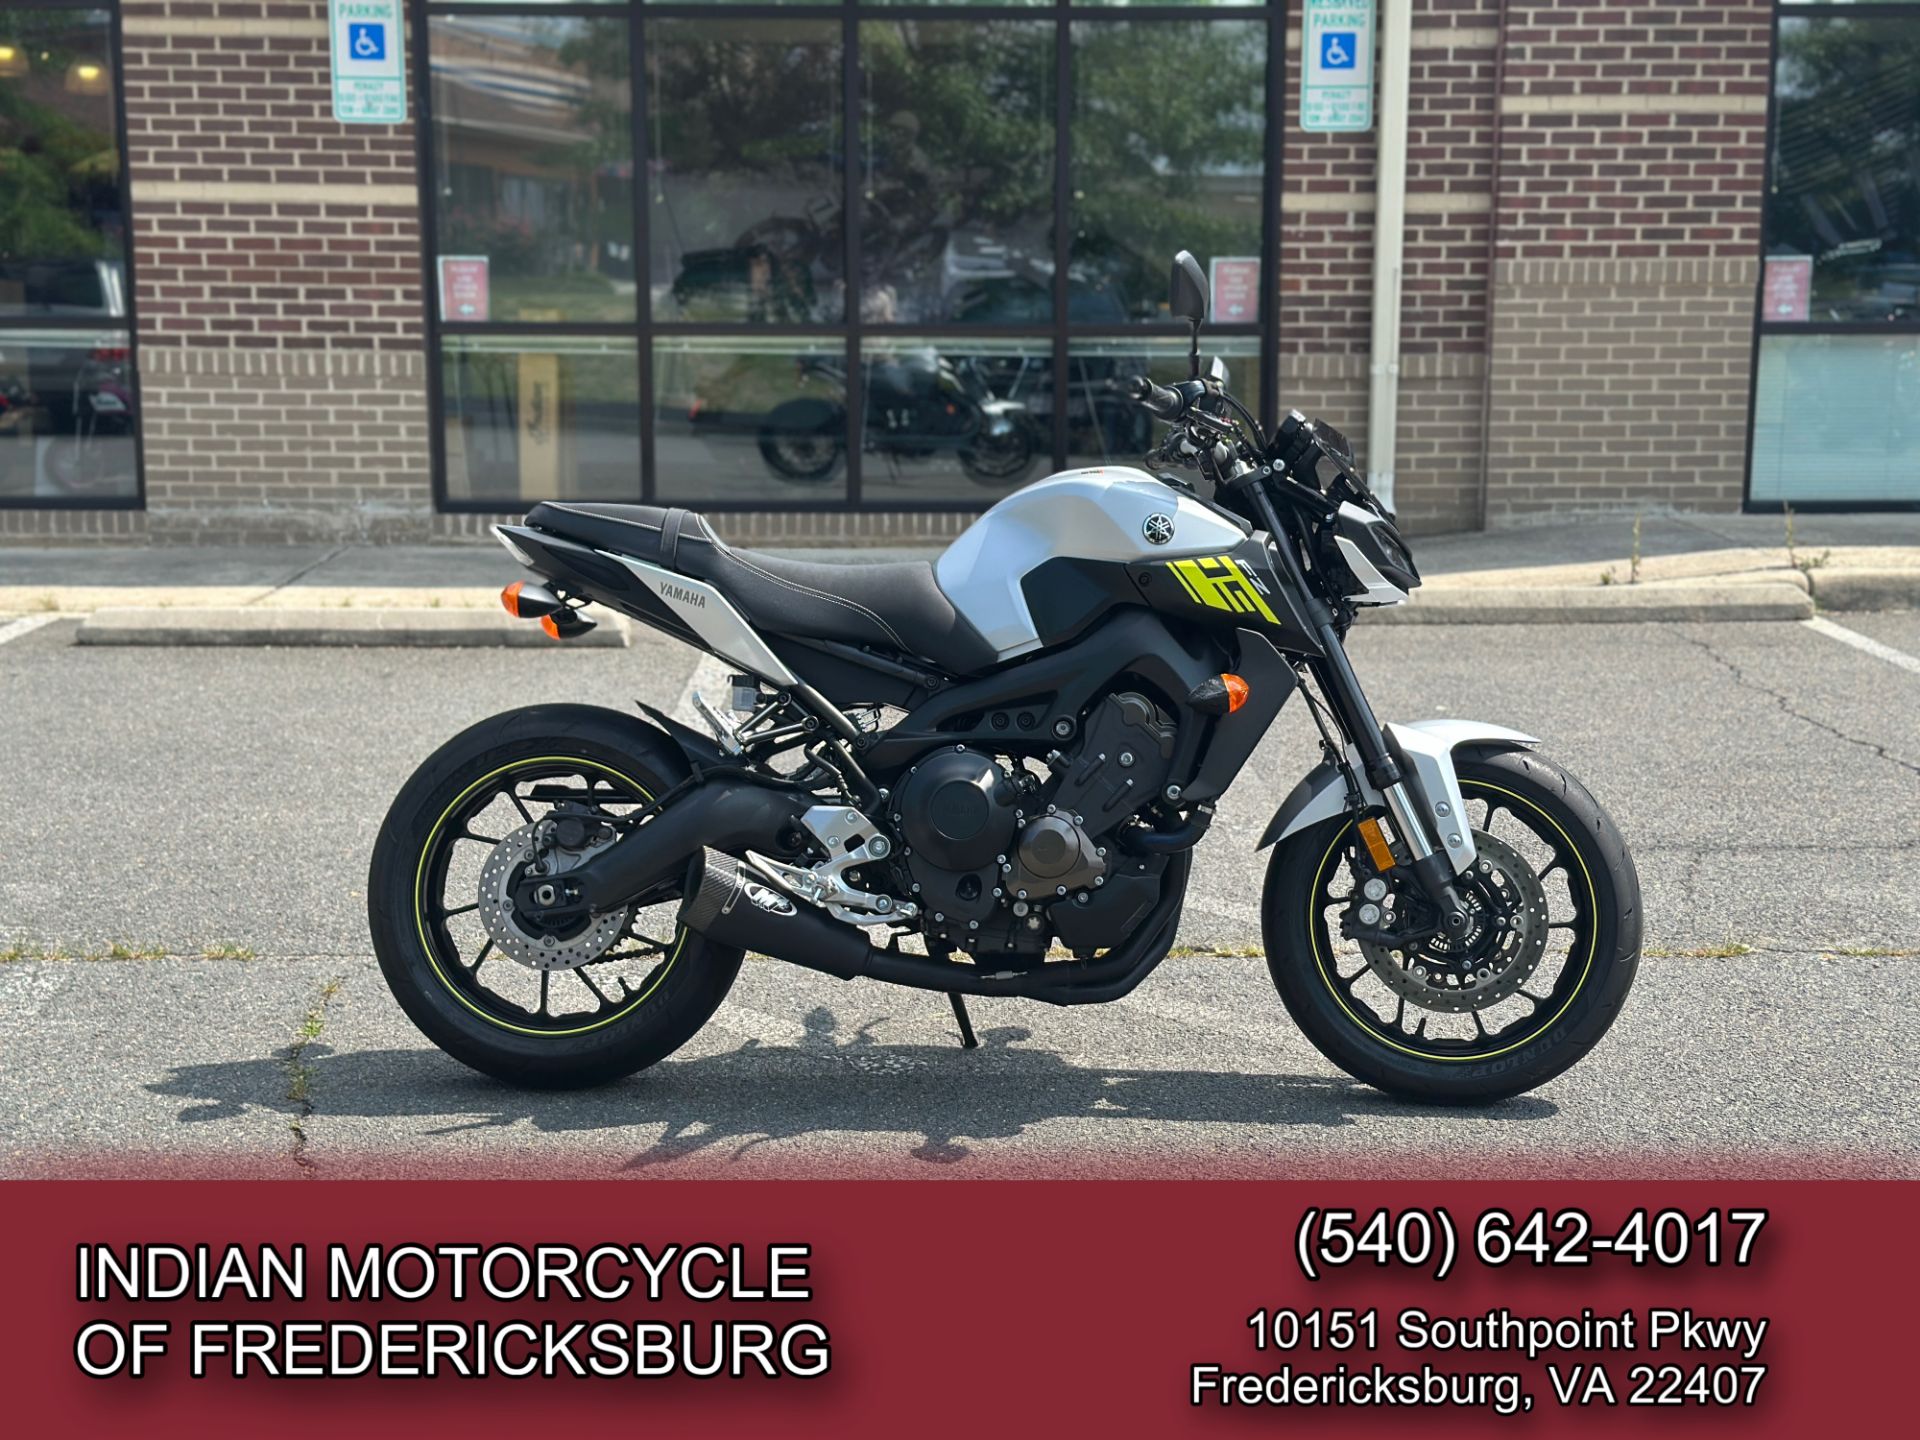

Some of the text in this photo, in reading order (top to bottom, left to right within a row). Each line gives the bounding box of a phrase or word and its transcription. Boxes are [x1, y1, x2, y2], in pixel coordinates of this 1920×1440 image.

[338, 3, 392, 18] PARKING
[1313, 13, 1366, 27] PARKING
[659, 581, 706, 609] YAMAHA
